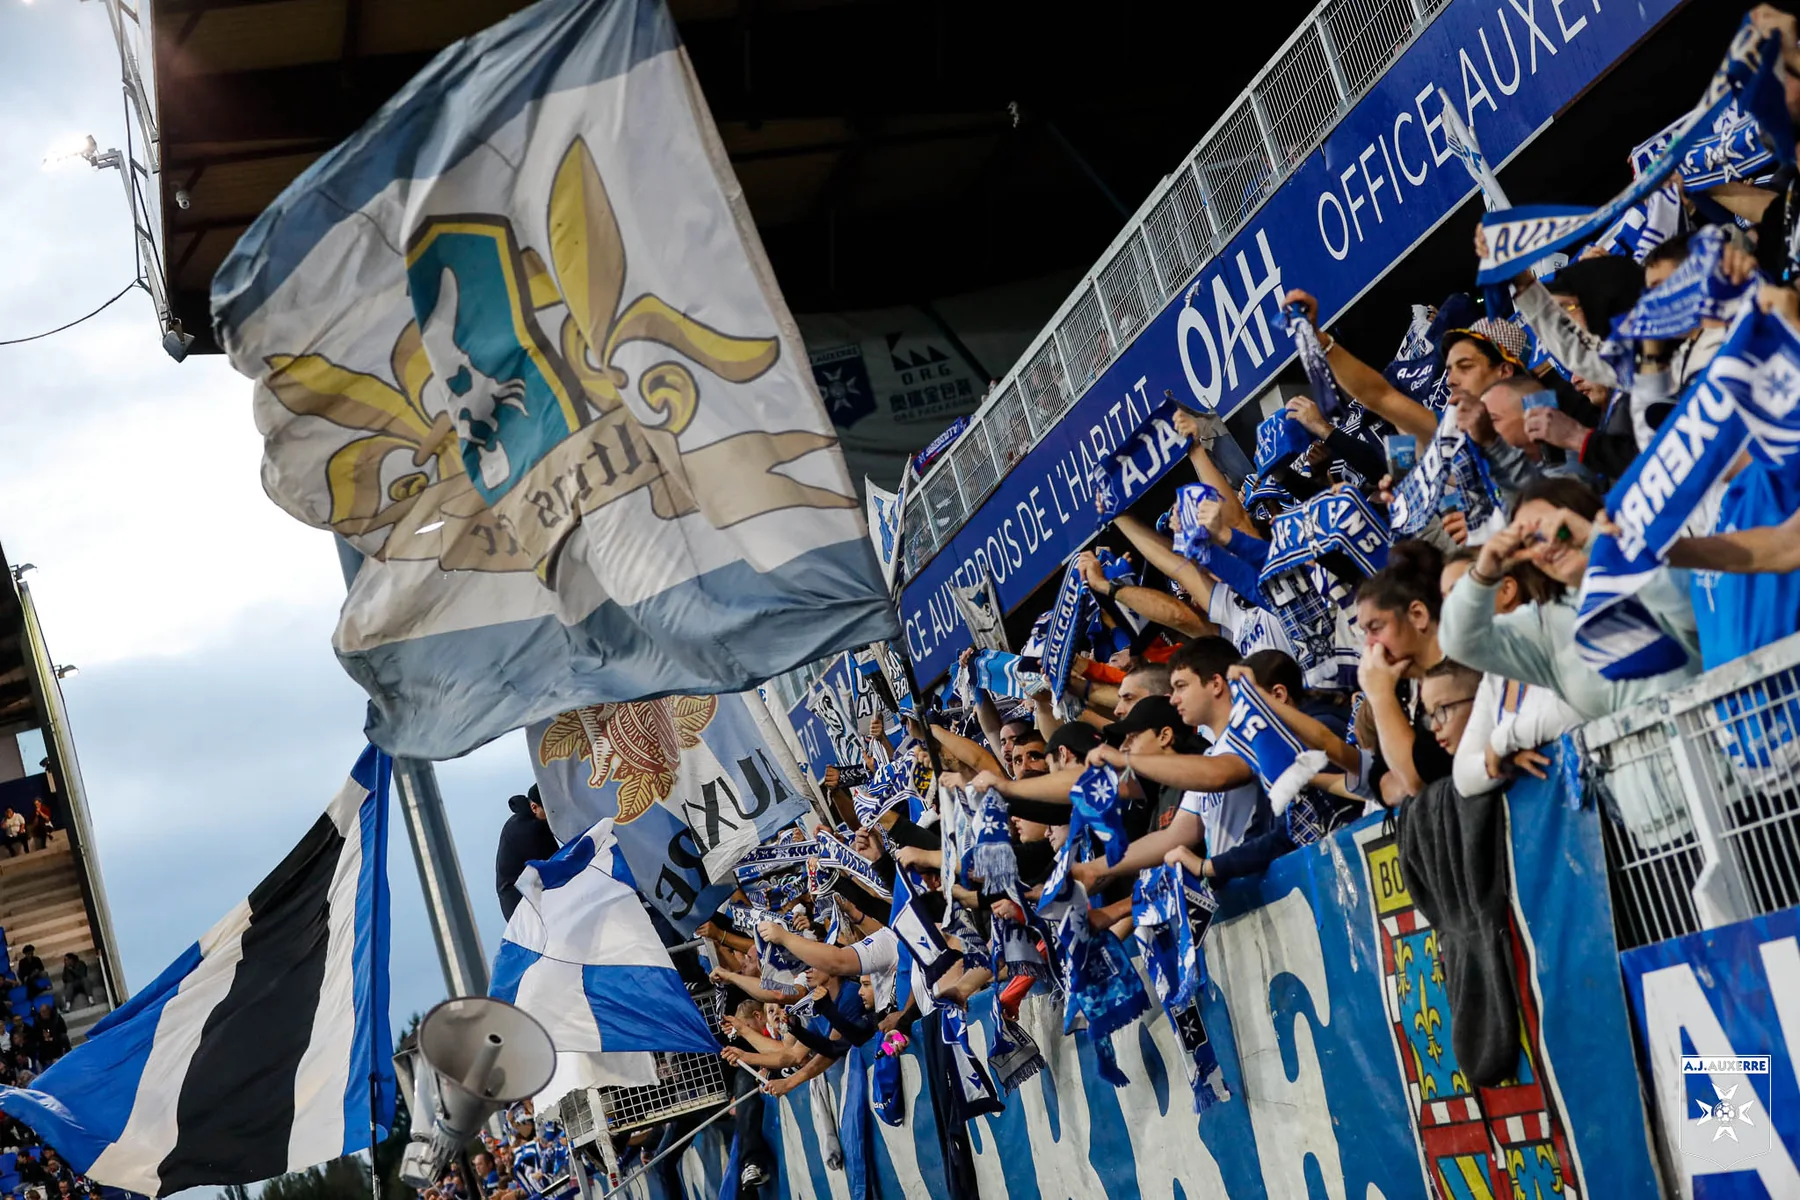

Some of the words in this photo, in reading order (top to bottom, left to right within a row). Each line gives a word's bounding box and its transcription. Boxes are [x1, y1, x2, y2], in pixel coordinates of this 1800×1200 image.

[1317, 82, 1452, 261] OFFICE
[1459, 0, 1602, 127] AUXE
[1177, 228, 1297, 410] OAH
[1016, 486, 1054, 554] DE
[1116, 416, 1188, 498] AJA
